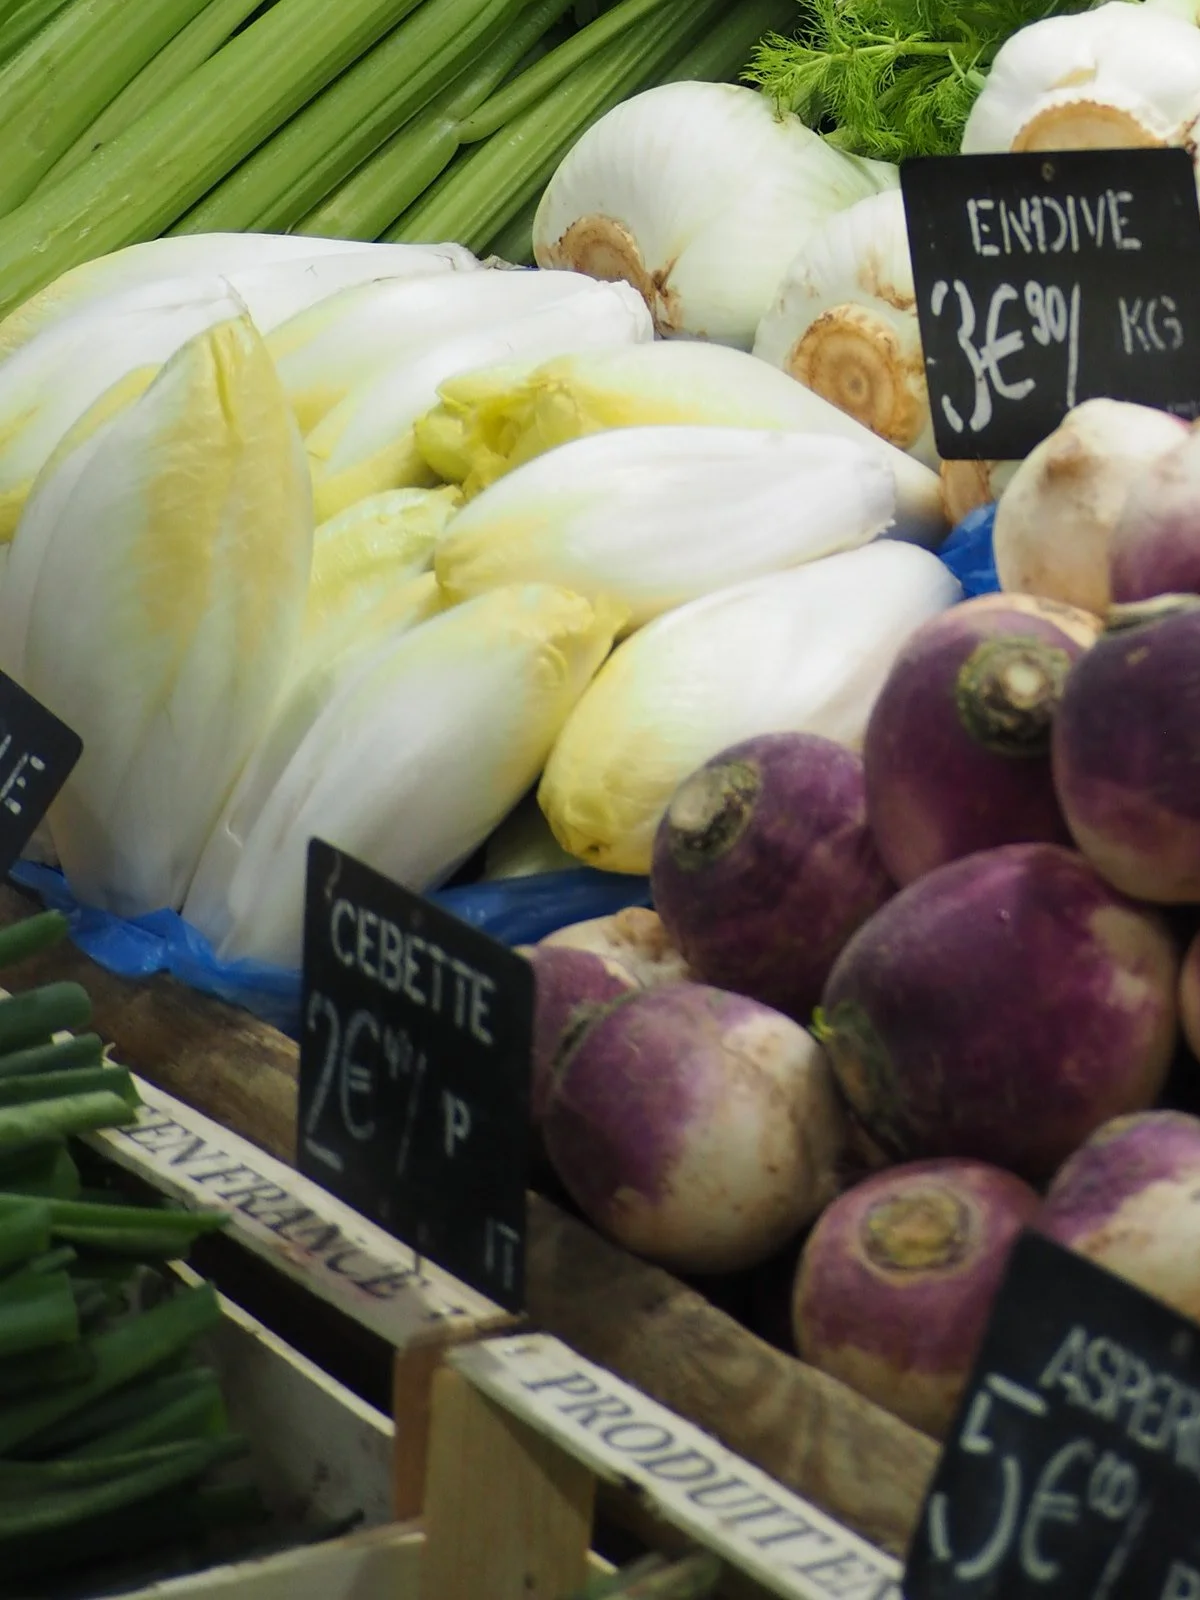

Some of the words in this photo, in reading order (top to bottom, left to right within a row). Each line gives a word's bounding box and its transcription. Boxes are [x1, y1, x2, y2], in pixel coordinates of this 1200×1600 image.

[966, 188, 1143, 258] ENDIVE
[1118, 294, 1185, 355] KG
[329, 897, 498, 1047] CEBETTE
[441, 1088, 473, 1159] P
[517, 1370, 835, 1549] PRODUIT
